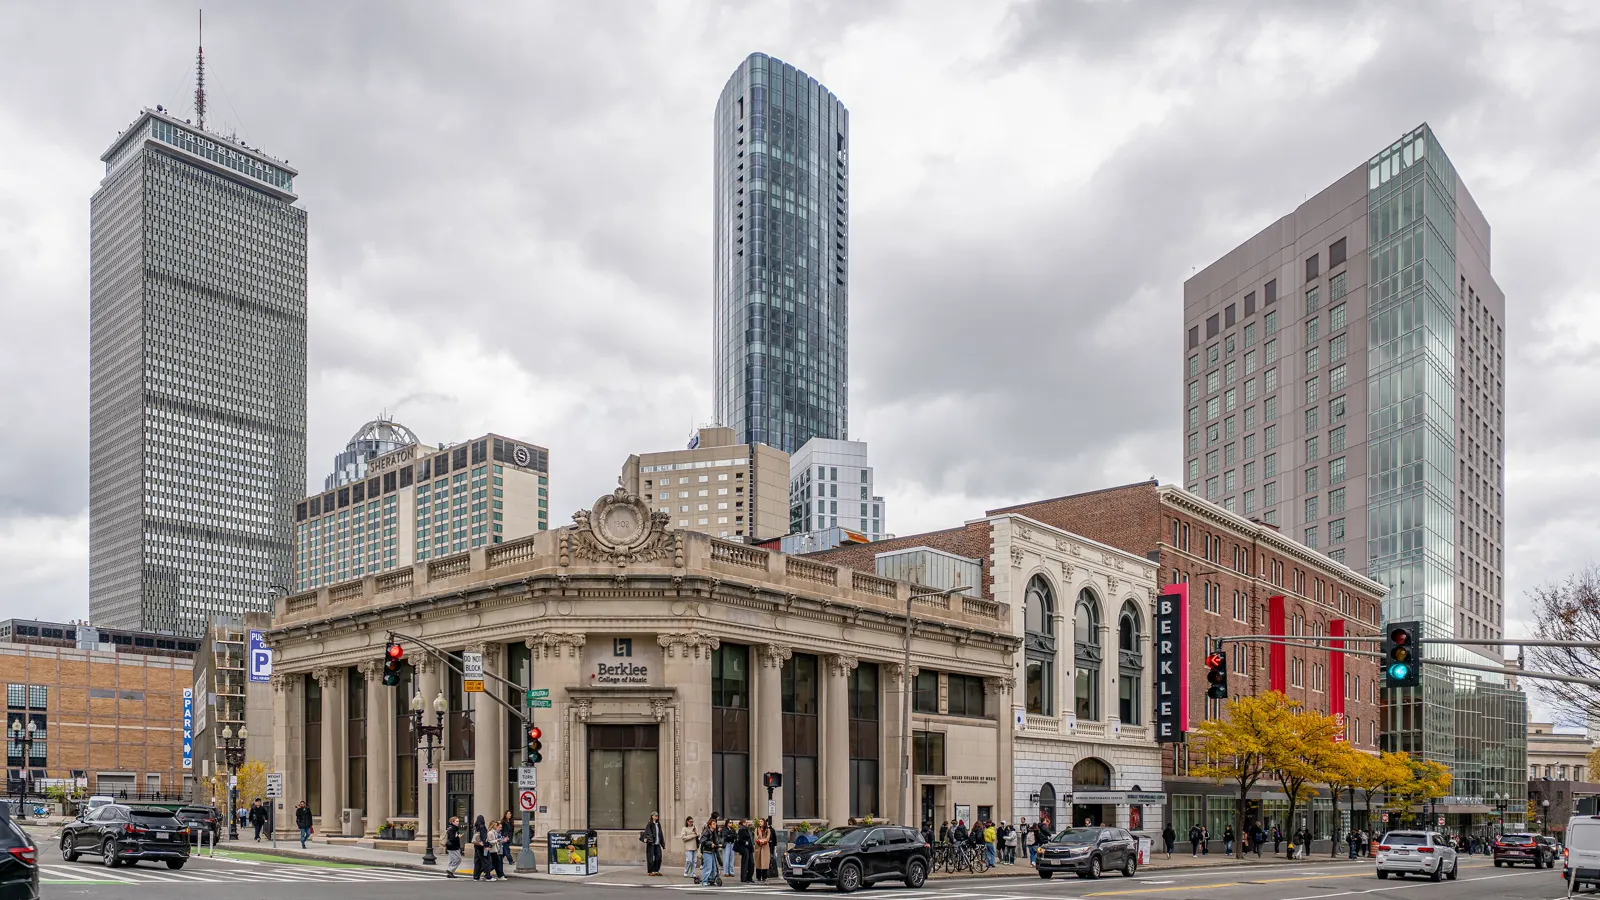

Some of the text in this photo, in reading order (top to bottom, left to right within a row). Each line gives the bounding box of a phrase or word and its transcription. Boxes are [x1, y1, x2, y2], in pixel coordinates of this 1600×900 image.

[176, 128, 272, 174] PRUDENTIAL
[370, 447, 414, 473] SHERATON
[613, 520, 630, 528] 1902
[255, 652, 269, 672] P
[598, 662, 647, 676] Berklee
[1161, 601, 1173, 736] BERKLEE
[598, 676, 620, 684] College
[184, 699, 192, 739] PARK
